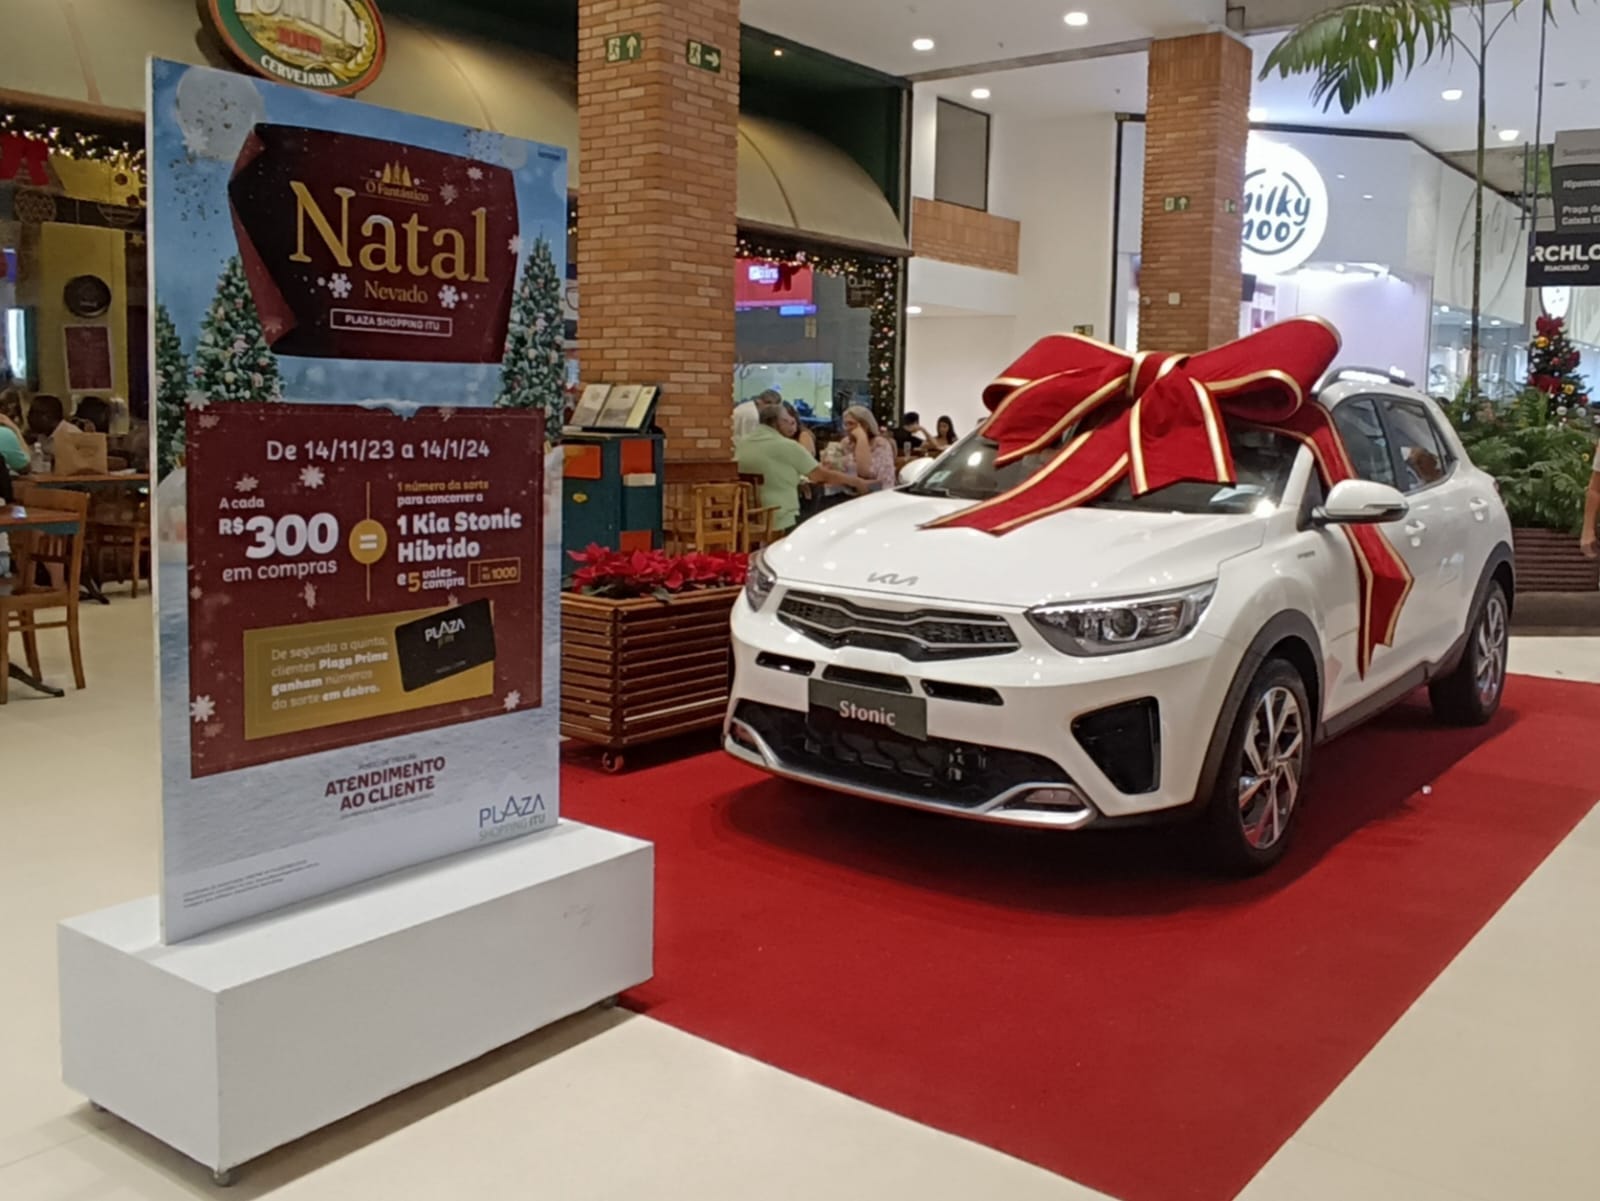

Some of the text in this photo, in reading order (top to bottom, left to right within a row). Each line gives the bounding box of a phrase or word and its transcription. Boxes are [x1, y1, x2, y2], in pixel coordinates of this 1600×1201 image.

[260, 55, 338, 87] CERVEJARIA
[289, 181, 490, 283] Natal
[364, 280, 429, 303] Nevado
[344, 315, 441, 331] PLAZA SHOPPING ITU
[266, 439, 491, 462] De 14/11/23 a 14/1/24
[219, 496, 266, 510] A cada
[397, 493, 484, 508] para concorrer a
[397, 507, 522, 536] 1 Kia Stonic
[398, 536, 481, 563] Híbrido
[222, 560, 338, 583] em compras
[397, 571, 421, 592] e 5
[422, 577, 466, 590] compra
[424, 618, 466, 642] PLAZA
[271, 648, 288, 661] De
[289, 642, 339, 659] segunda
[355, 652, 389, 665] Prime
[271, 677, 323, 697] ganham
[322, 689, 341, 702] em
[839, 700, 897, 727] Stonic
[324, 755, 446, 798] ATENDIMENTO
[340, 793, 366, 812] AO
[367, 775, 436, 805] CLIENTE
[478, 793, 546, 829] PLAZA
